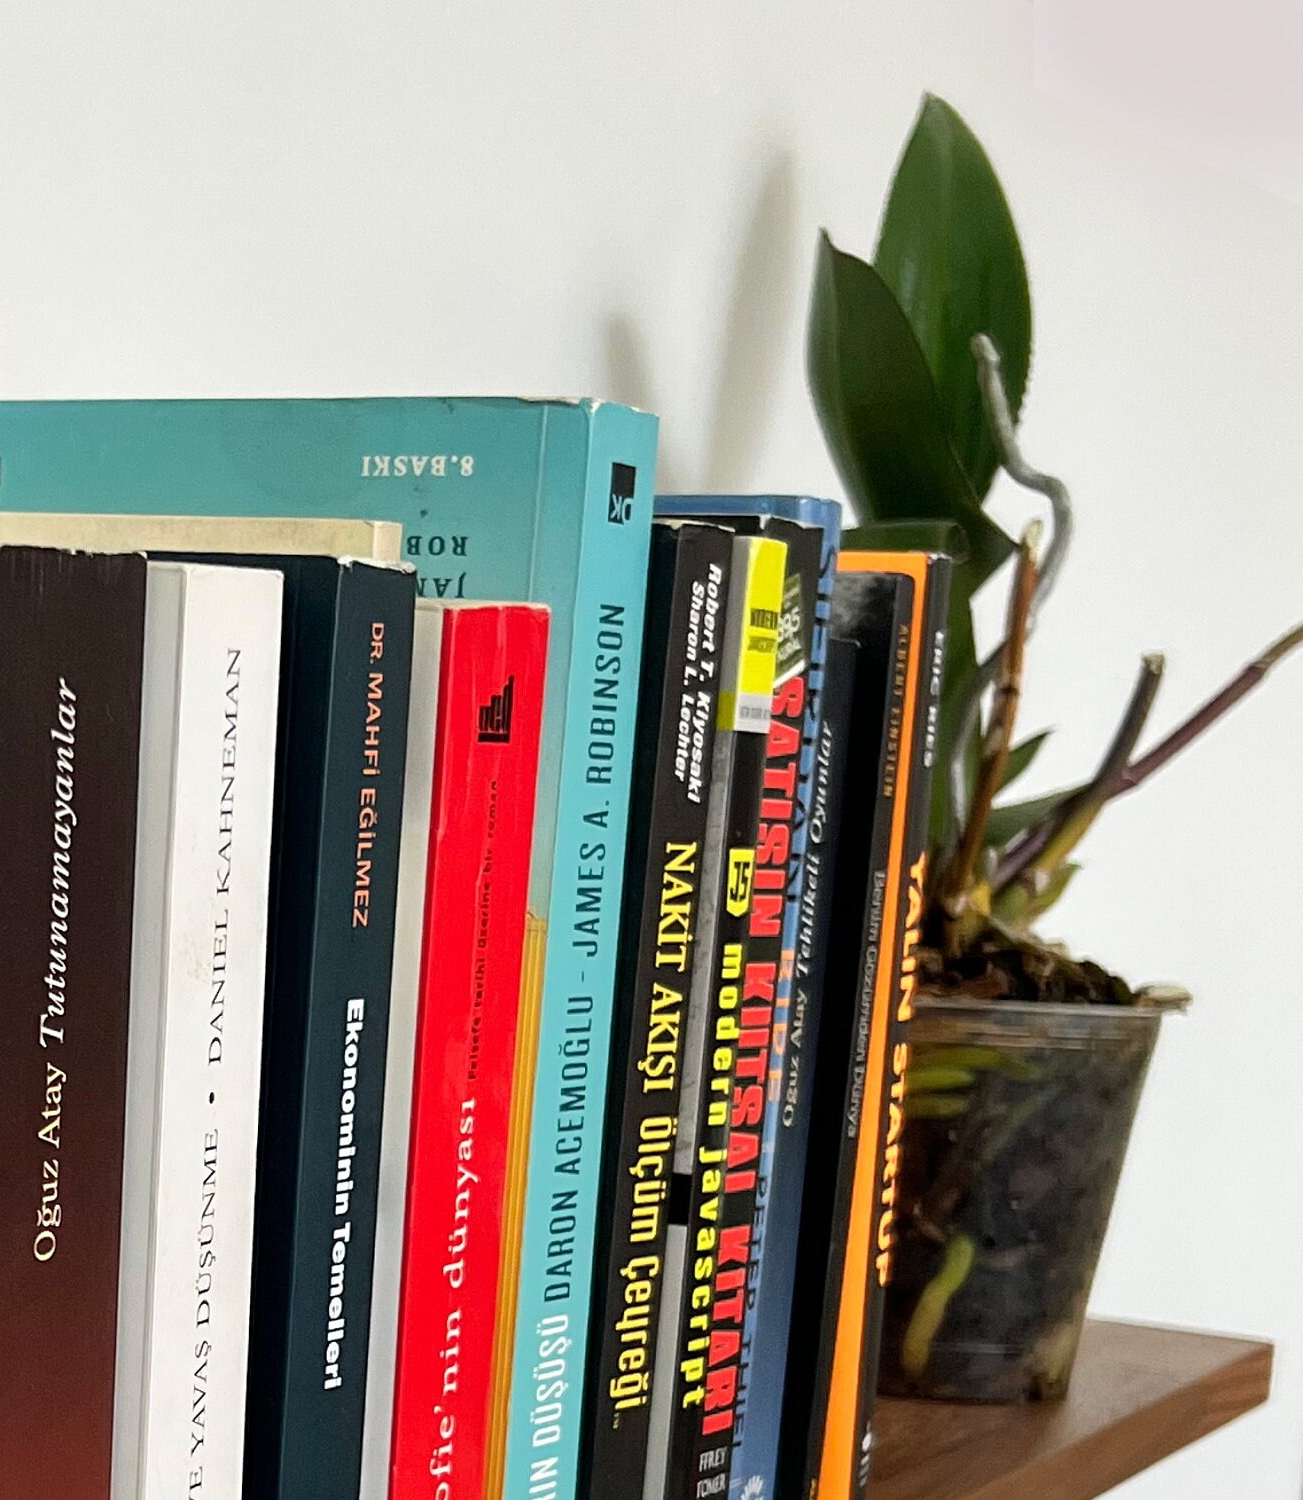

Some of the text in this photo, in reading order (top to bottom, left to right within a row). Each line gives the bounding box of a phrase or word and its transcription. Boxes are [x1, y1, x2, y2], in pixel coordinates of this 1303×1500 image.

[360, 453, 474, 478] 8.BASKI
[586, 604, 625, 785] ROBINSON
[674, 581, 704, 782] Sharon L. Lechter
[686, 563, 722, 803] Robert T. Kiyosaki
[216, 648, 242, 896] KAHNEMAN
[352, 622, 385, 928] DR. MAHFİ EĞİLMEZ
[583, 799, 611, 829] A.
[808, 720, 834, 843] Oyunlar
[33, 678, 77, 1262] Oğuz Atay Tutunamayanlar
[573, 842, 606, 958] JAMES
[655, 842, 696, 972] NAKİT
[794, 853, 821, 977] Tehlikeli
[208, 910, 229, 1065] DANIEL
[638, 982, 683, 1092] AKIŞI
[789, 988, 807, 1048] Atay
[554, 997, 595, 1176] ACEMOĞLU
[875, 851, 926, 1287] YALIN STARTUP
[196, 1128, 219, 1328] DÜŞÜNME
[323, 998, 365, 1390] Ekonominin Temelleri
[442, 1096, 482, 1289] dünyası
[544, 1191, 579, 1303] DARON
[628, 1116, 678, 1242] Ölçüm
[682, 944, 743, 1409] modern javascript
[191, 1340, 212, 1458] YAVAŞ
[532, 1314, 570, 1448] DÜŞÜŞÜ
